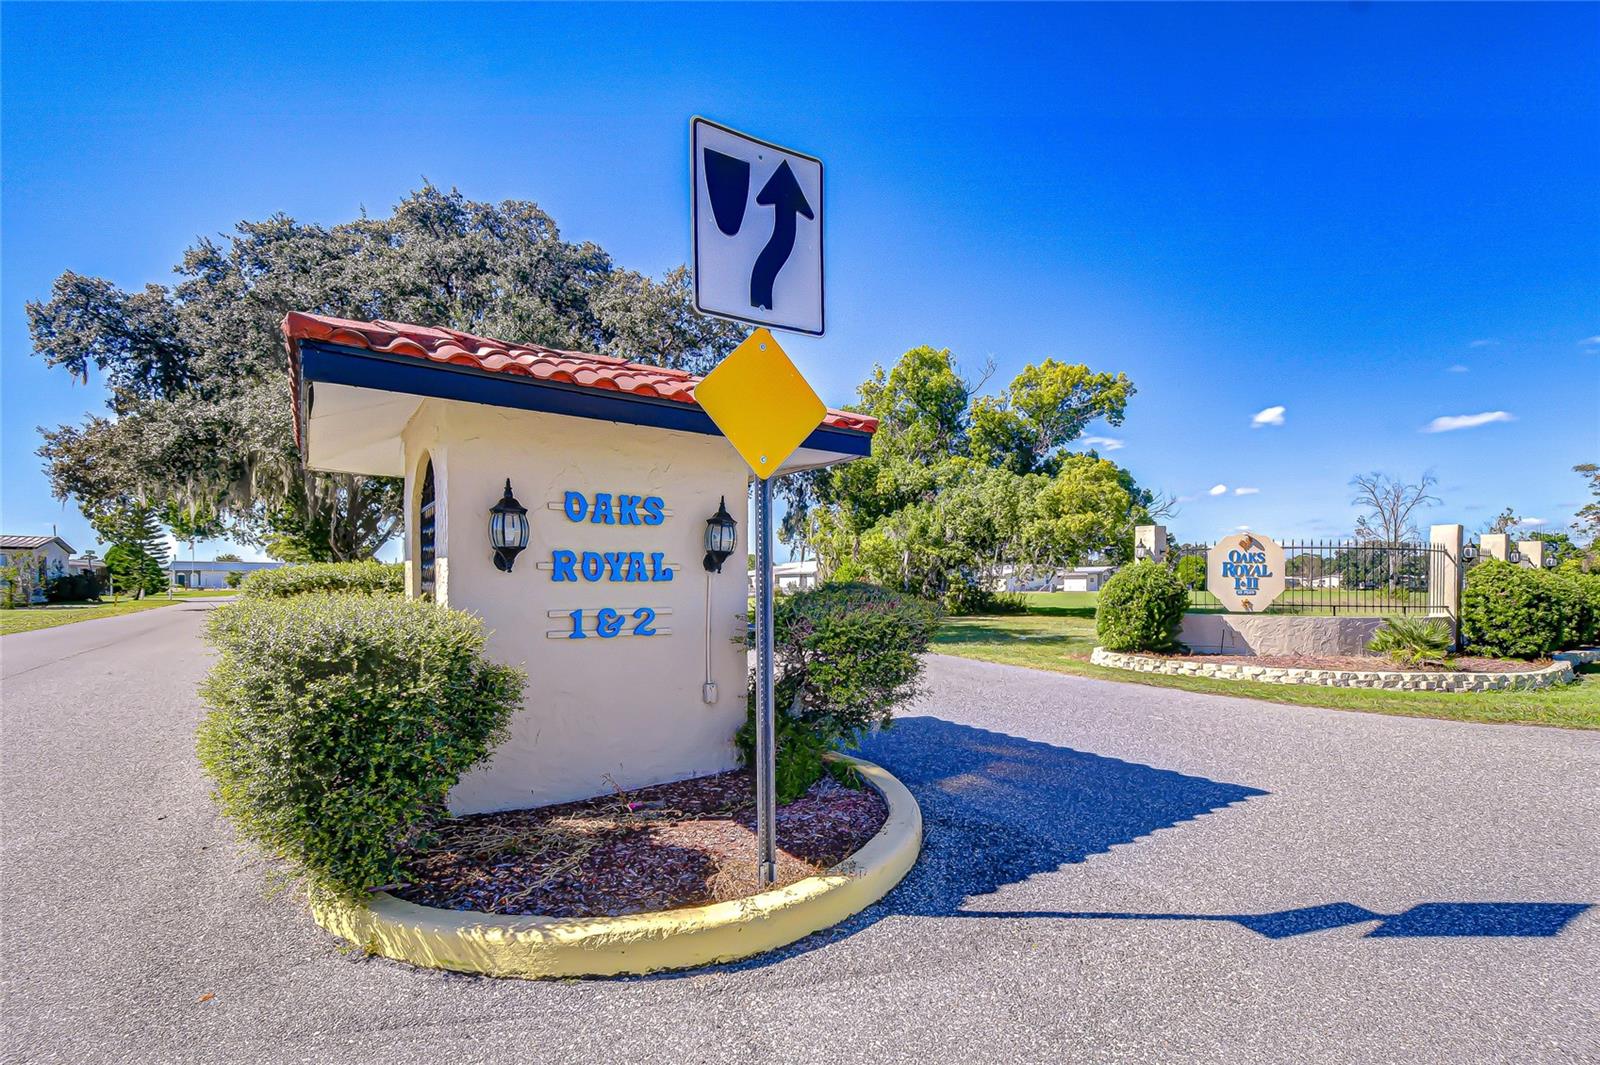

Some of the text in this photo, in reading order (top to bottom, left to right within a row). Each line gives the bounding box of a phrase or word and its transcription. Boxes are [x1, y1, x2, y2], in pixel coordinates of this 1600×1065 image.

[564, 491, 665, 525] OAKS
[551, 550, 674, 582] ROYAL
[1228, 549, 1266, 563] OAKS
[1222, 562, 1273, 577] ROYAL
